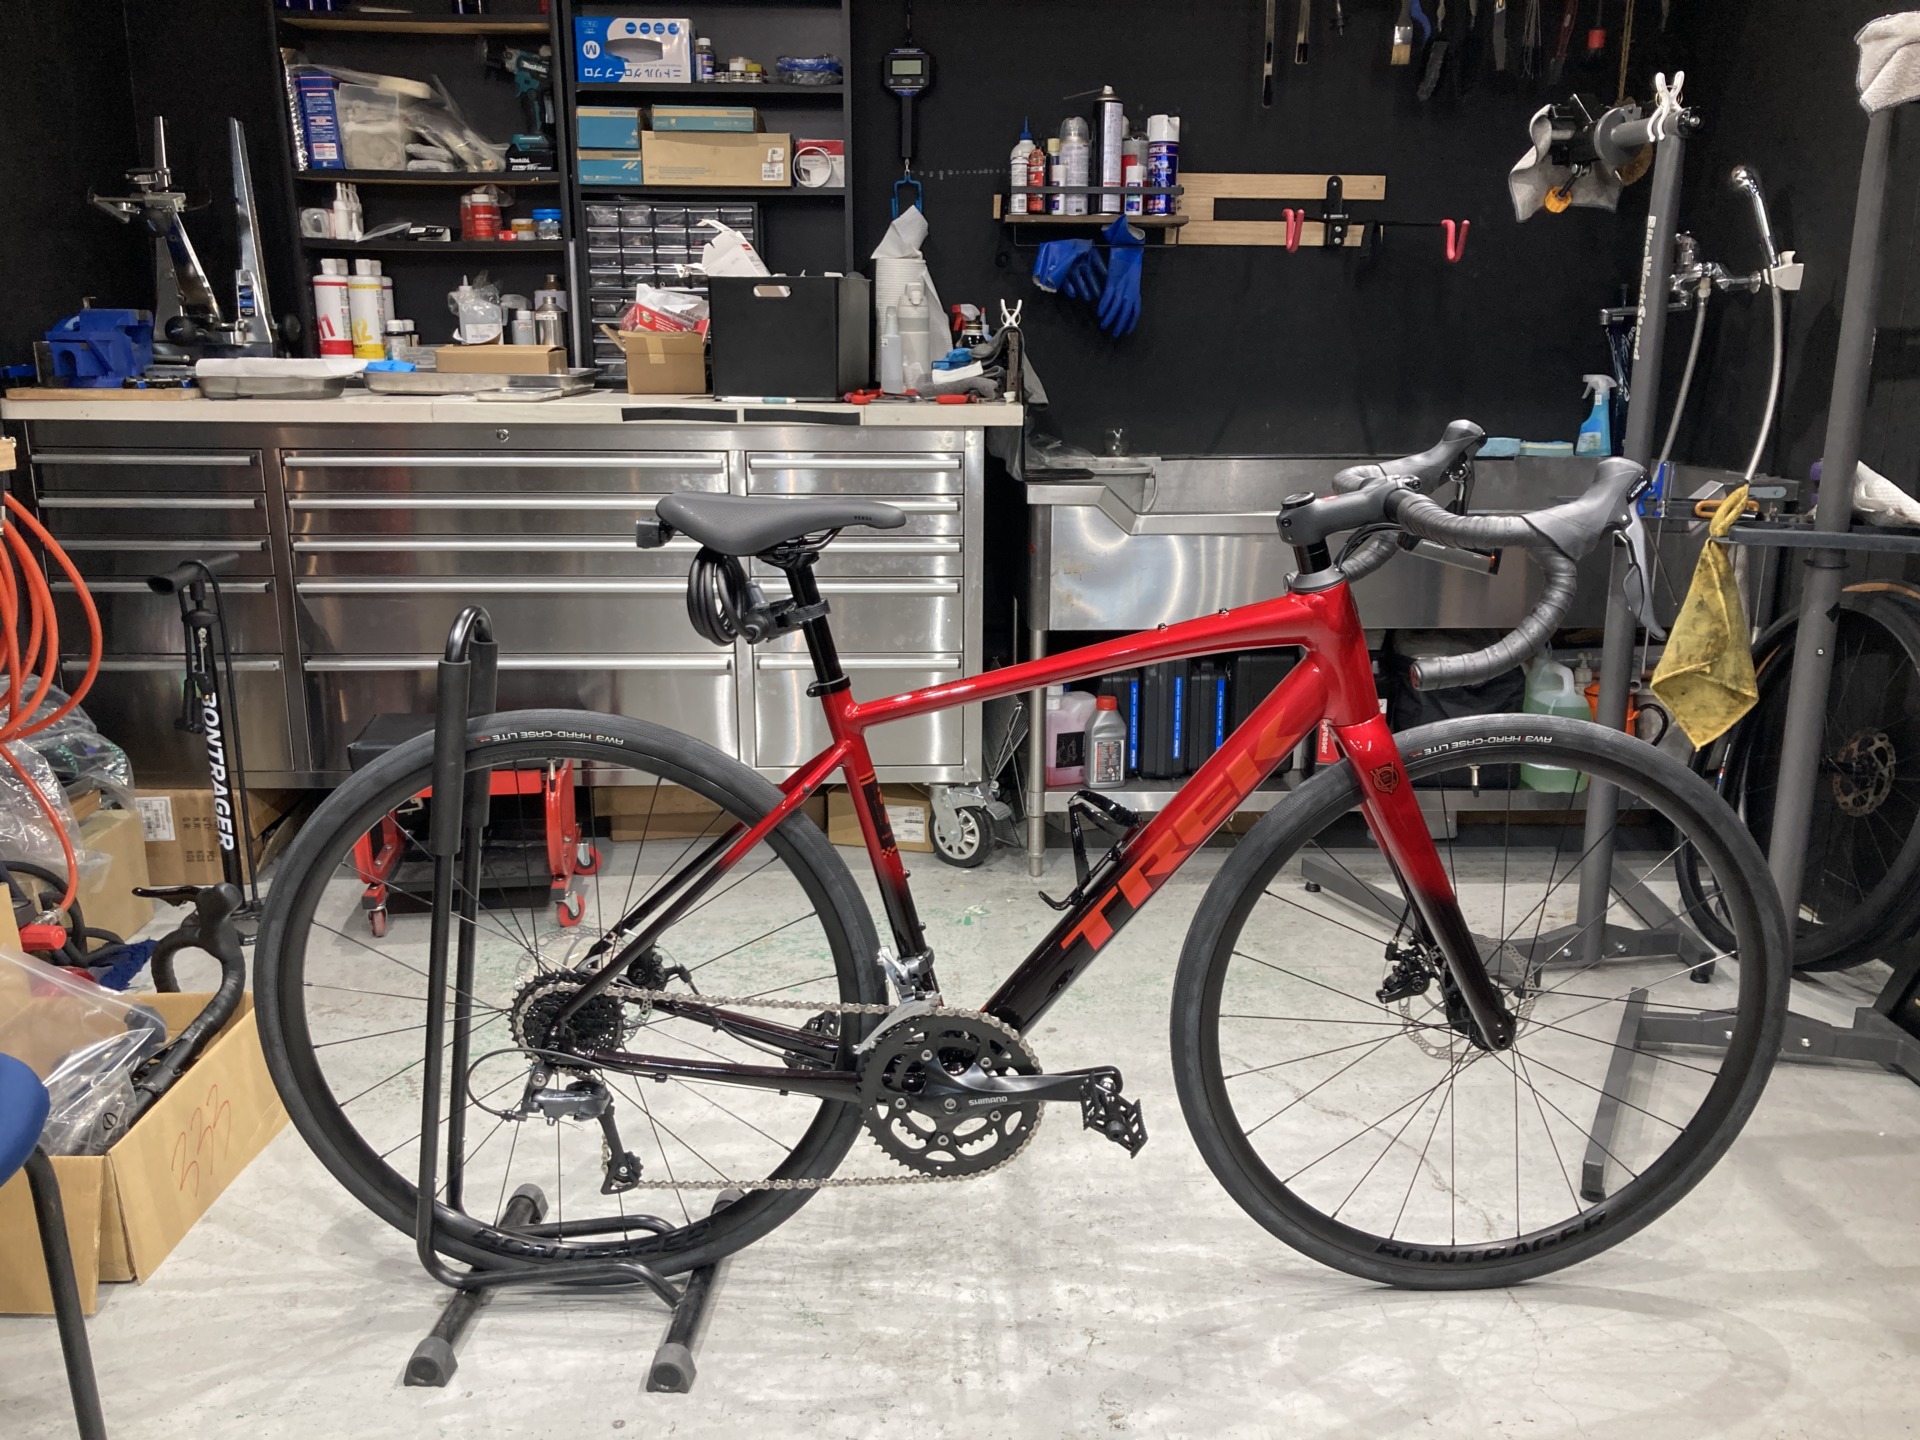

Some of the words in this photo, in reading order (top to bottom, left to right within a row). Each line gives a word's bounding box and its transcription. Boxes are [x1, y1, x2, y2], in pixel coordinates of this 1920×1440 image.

[585, 44, 597, 55] M
[492, 731, 519, 743] LITE
[520, 731, 592, 740] HARD-CASE
[1451, 735, 1522, 750] HARD-CASE
[1424, 743, 1450, 756] LITE
[1060, 704, 1306, 951] TREK
[968, 1096, 1008, 1106] SHIMANO
